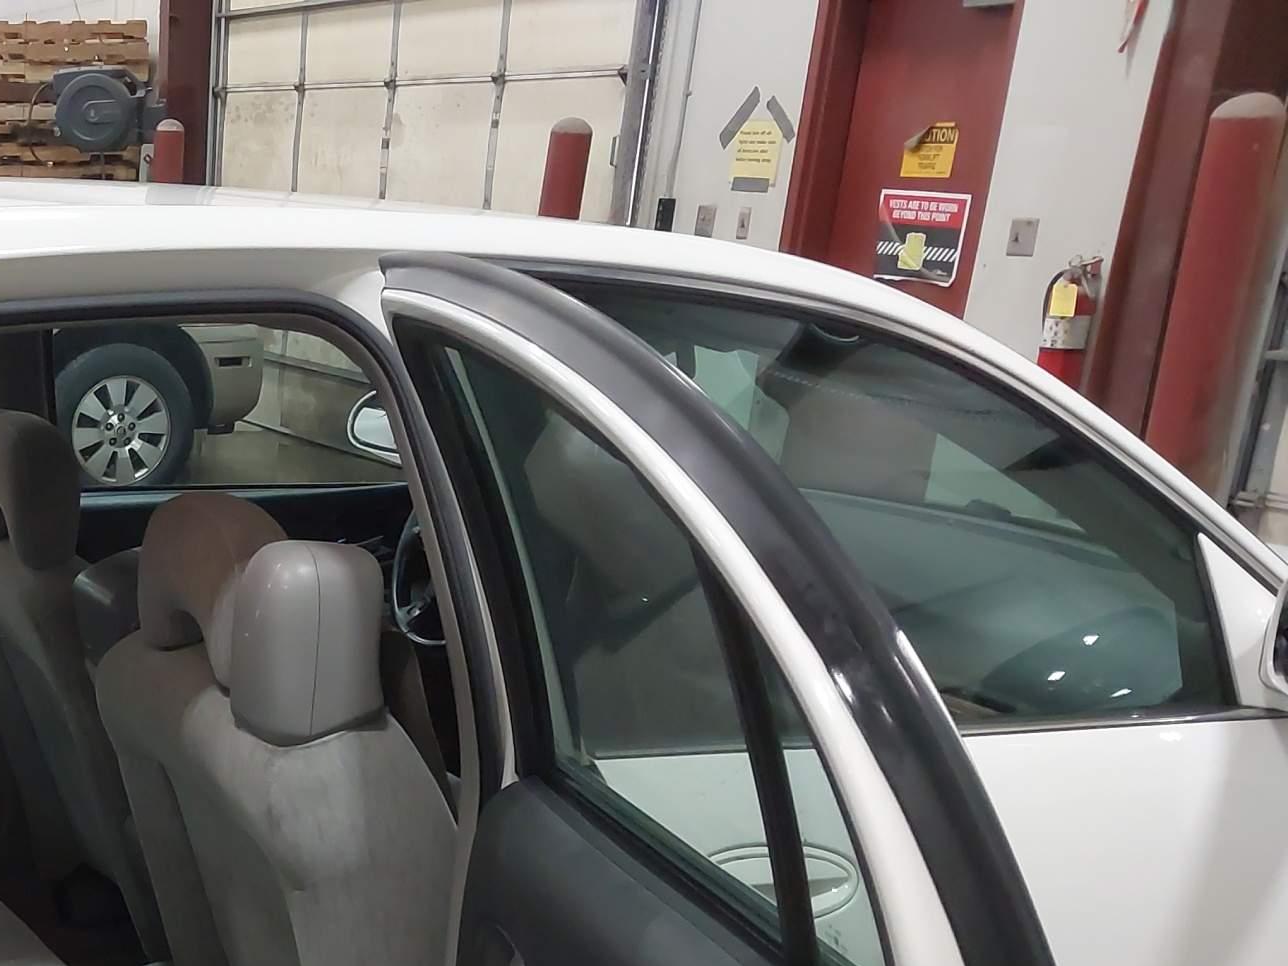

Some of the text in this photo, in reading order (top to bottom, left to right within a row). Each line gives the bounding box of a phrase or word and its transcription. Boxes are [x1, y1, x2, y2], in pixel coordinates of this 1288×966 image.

[908, 200, 920, 210] ARE
[920, 201, 929, 211] TO
[917, 211, 931, 221] THIS
[931, 212, 952, 222] POINT
